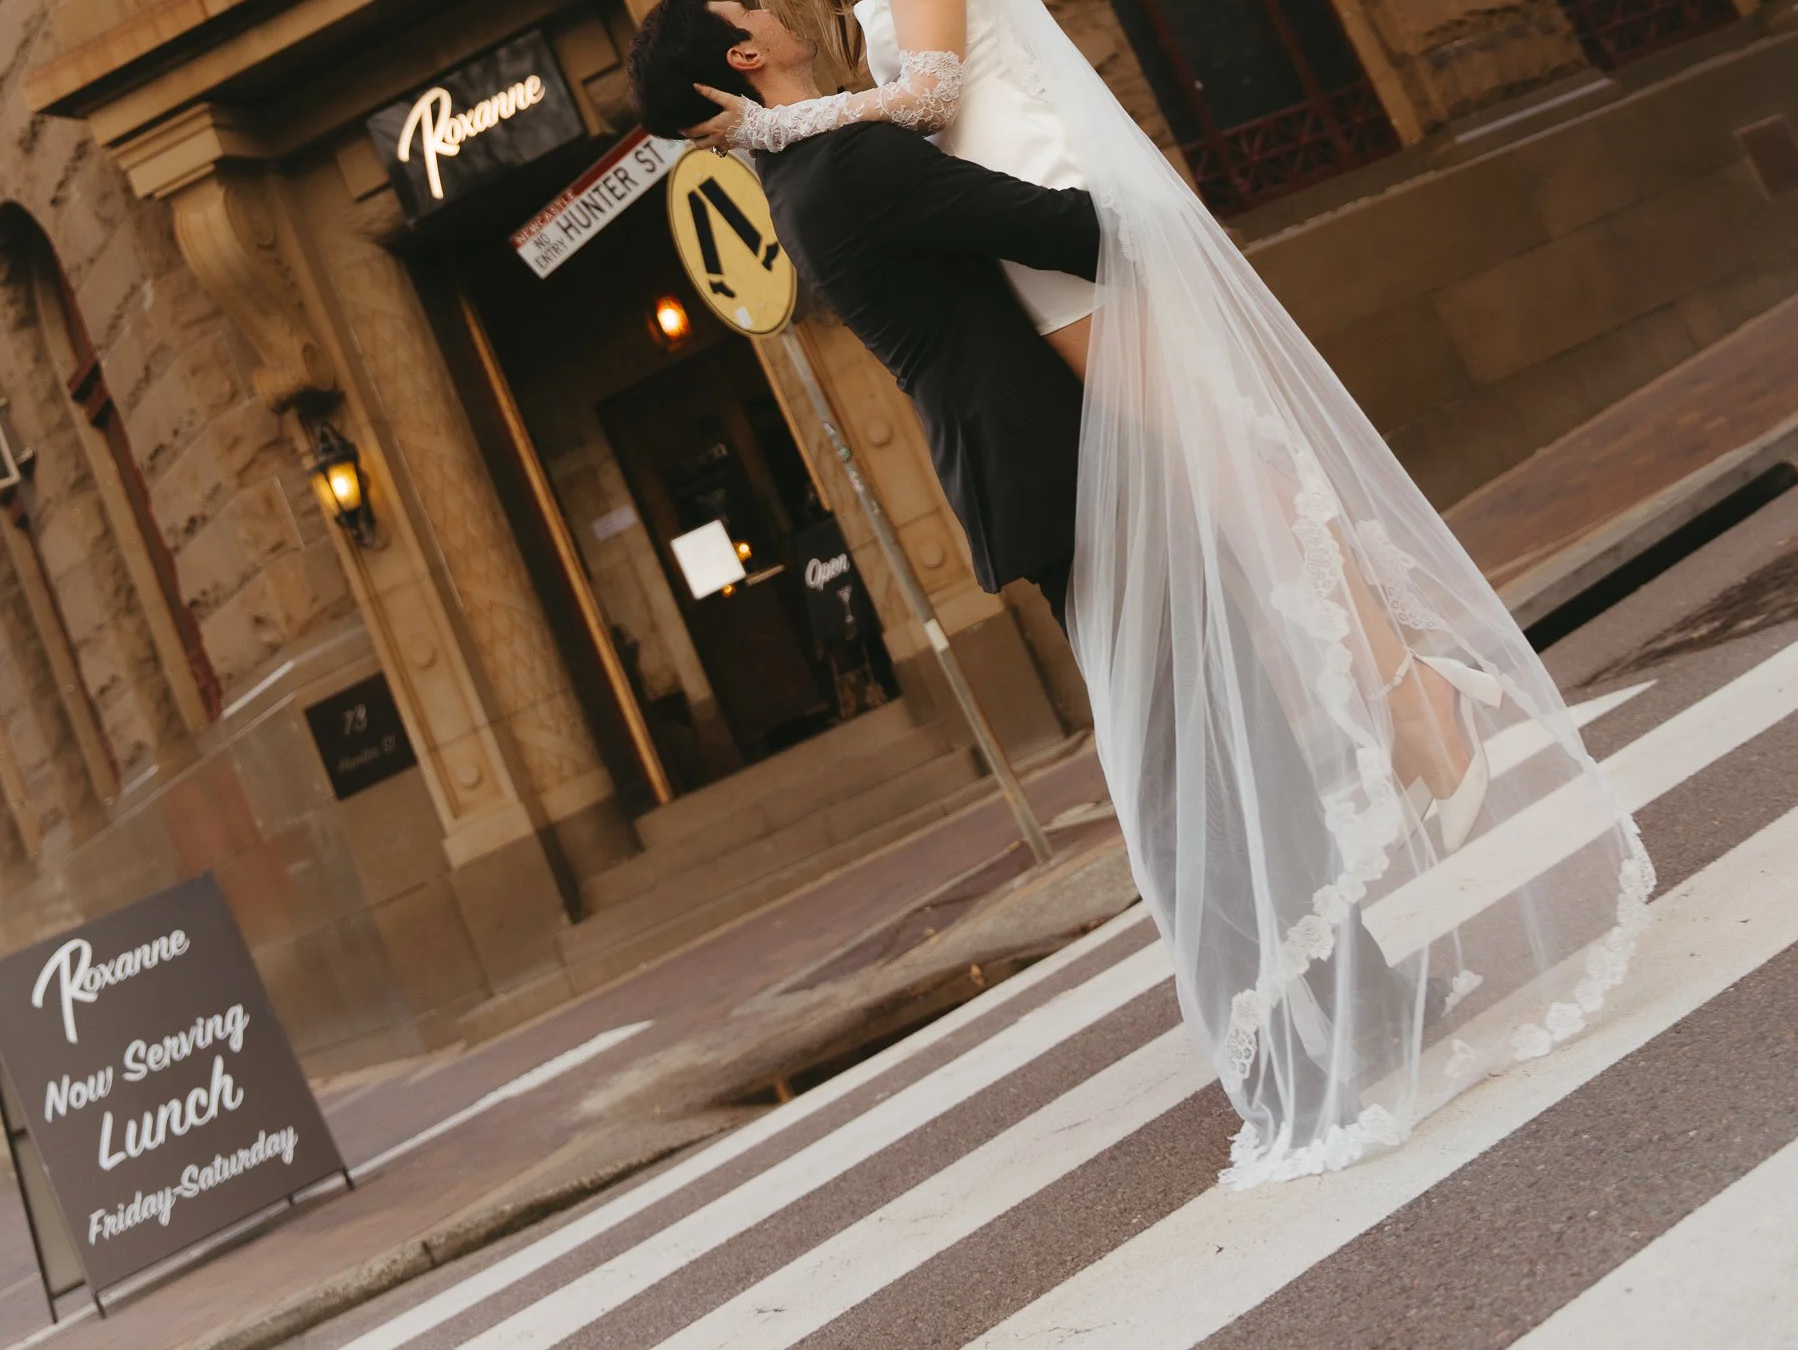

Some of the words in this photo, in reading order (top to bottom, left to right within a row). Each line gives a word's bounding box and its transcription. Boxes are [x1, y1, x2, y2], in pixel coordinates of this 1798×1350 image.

[398, 74, 546, 200] Roxanne
[533, 232, 551, 250] NO
[556, 166, 639, 241] HUNTER
[634, 141, 665, 173] ST
[535, 238, 569, 270] ENTRY
[804, 553, 850, 592] Open
[31, 929, 190, 1044] Roxanne
[44, 1065, 114, 1123] Now
[122, 1003, 250, 1082] Serving
[98, 1054, 244, 1171] Lunch
